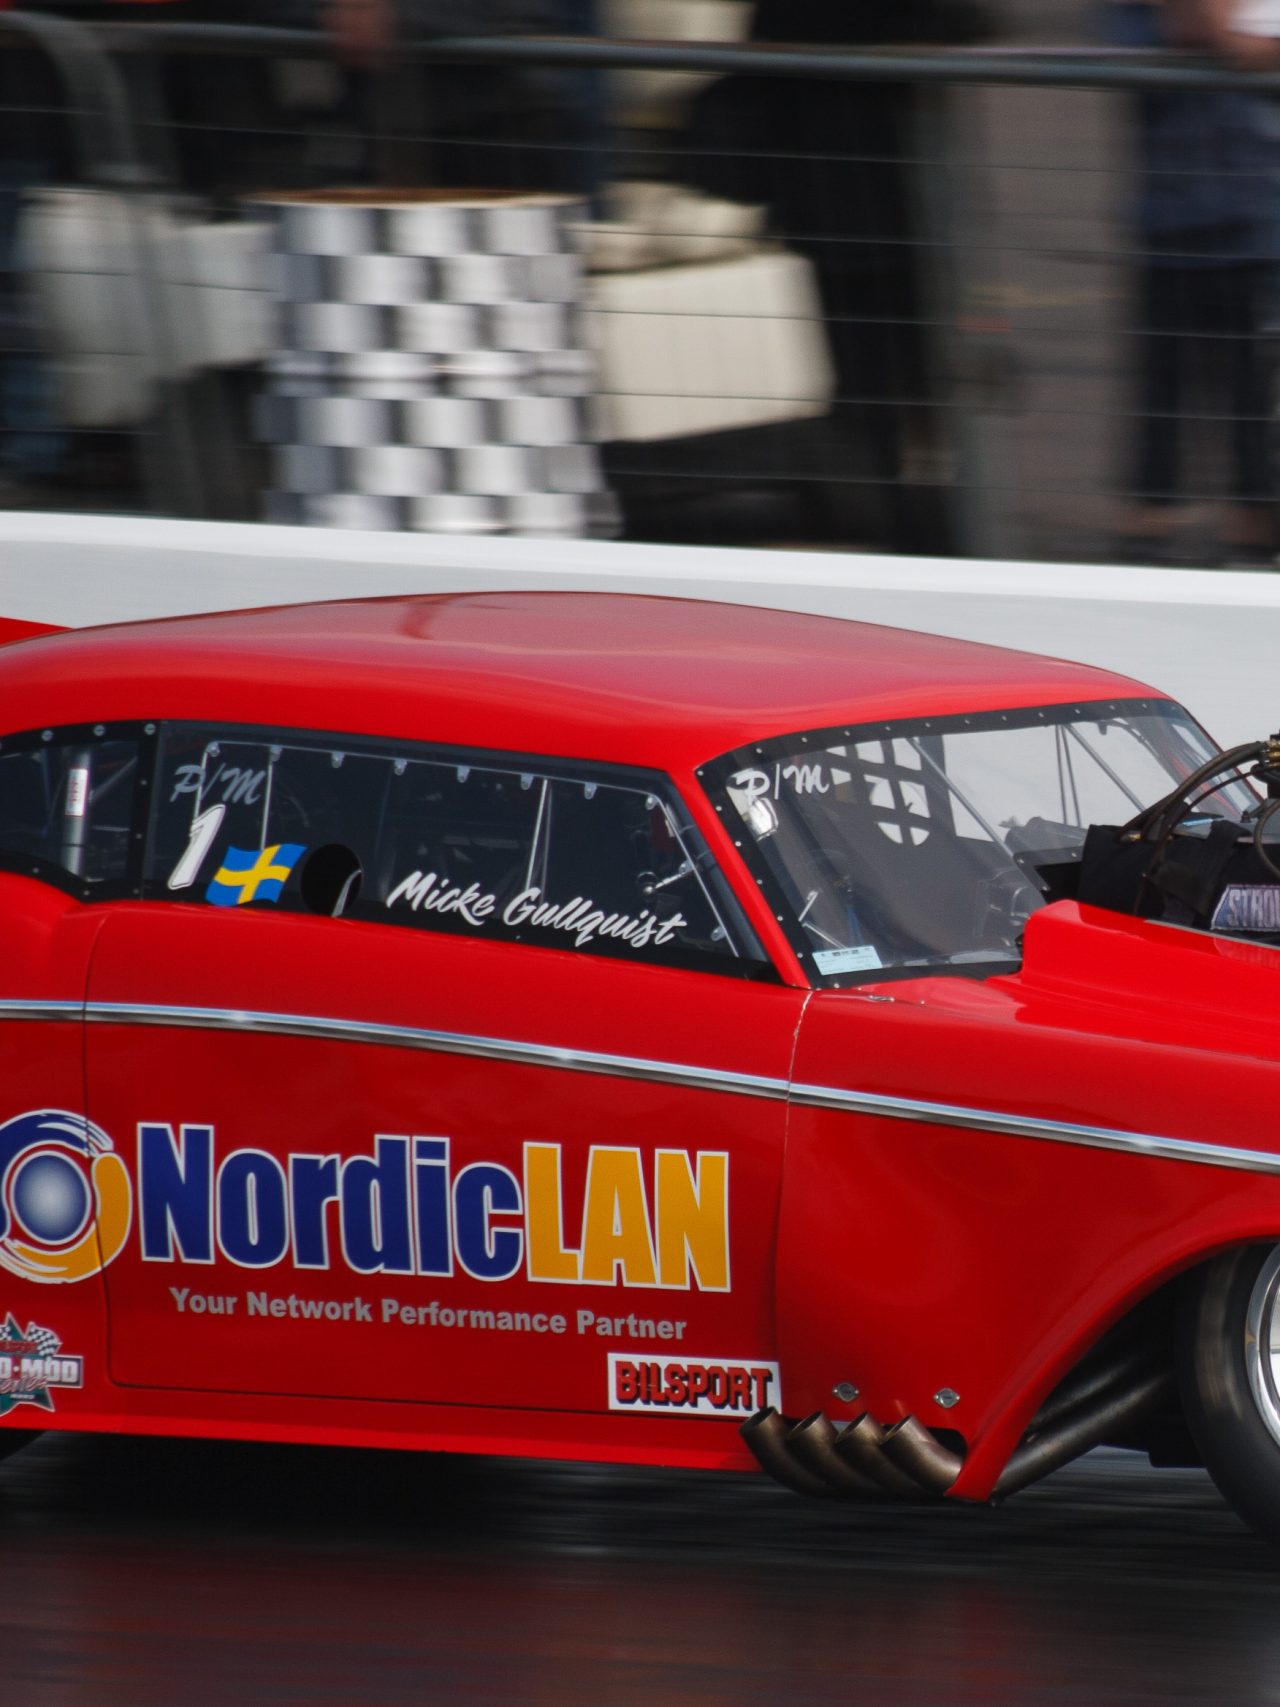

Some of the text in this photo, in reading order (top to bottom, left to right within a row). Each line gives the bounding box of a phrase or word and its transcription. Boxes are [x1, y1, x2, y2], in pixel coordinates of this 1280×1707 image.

[168, 804, 226, 890] 1
[386, 871, 687, 948] Micke Gullquist
[137, 1122, 731, 1292] NordicLAN
[169, 1286, 687, 1340] Your Network Performance Partner
[615, 1360, 773, 1411] BILSPORT
